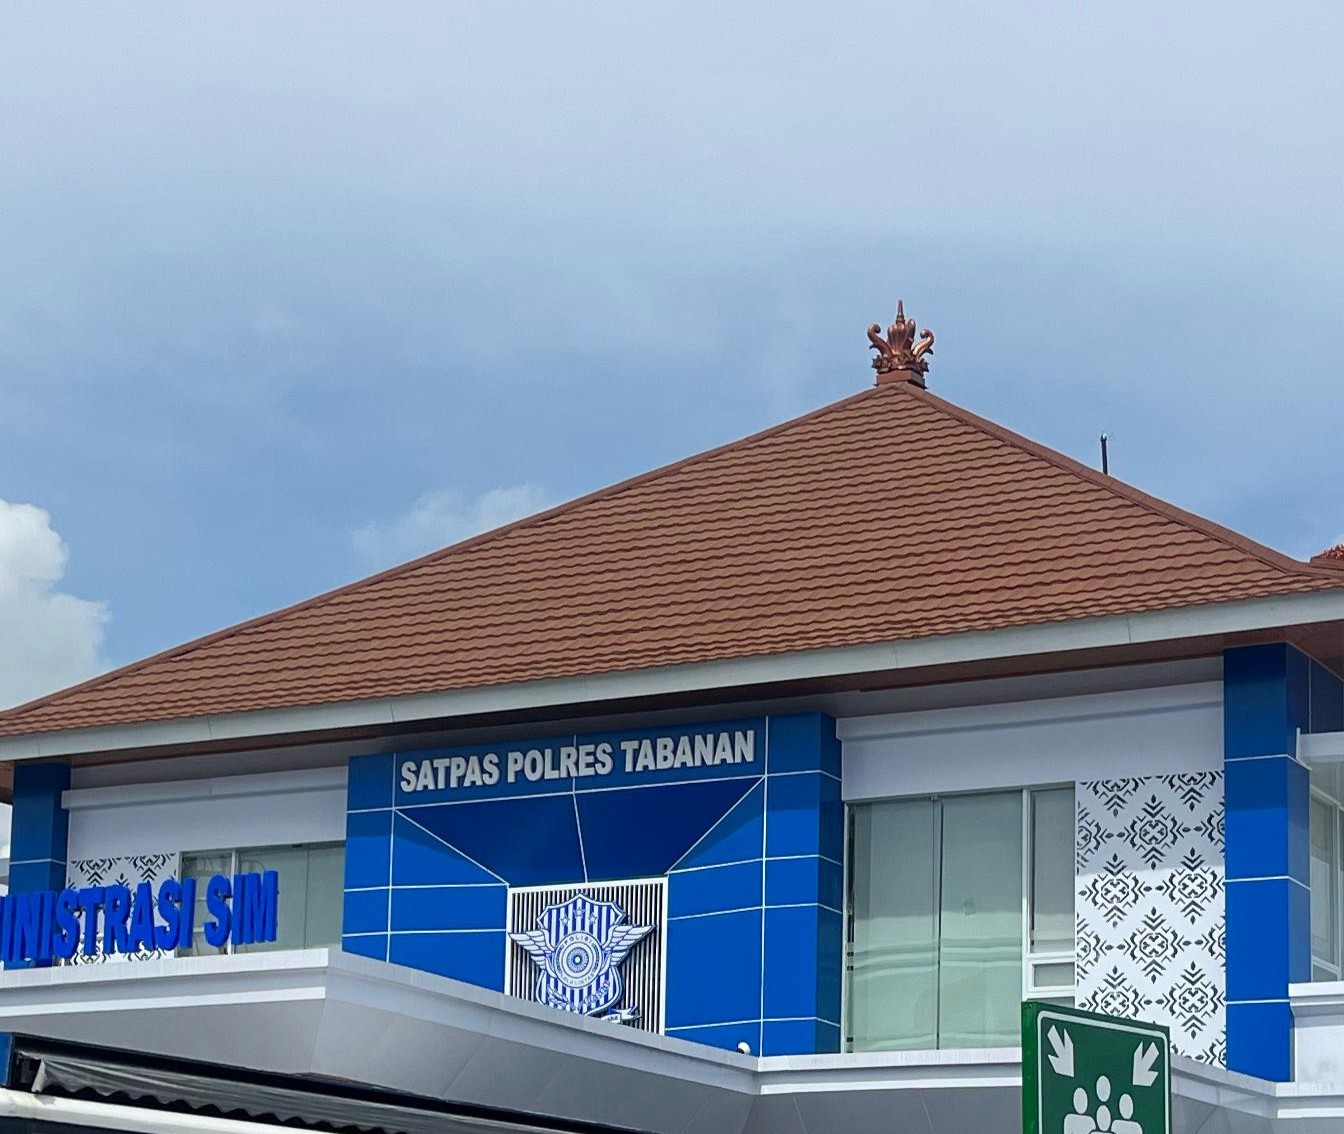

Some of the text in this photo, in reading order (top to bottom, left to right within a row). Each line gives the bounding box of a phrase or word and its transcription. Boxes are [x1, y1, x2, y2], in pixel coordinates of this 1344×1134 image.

[400, 730, 755, 793] SATPAS POLRES TABANAN
[204, 870, 279, 948] SIM
